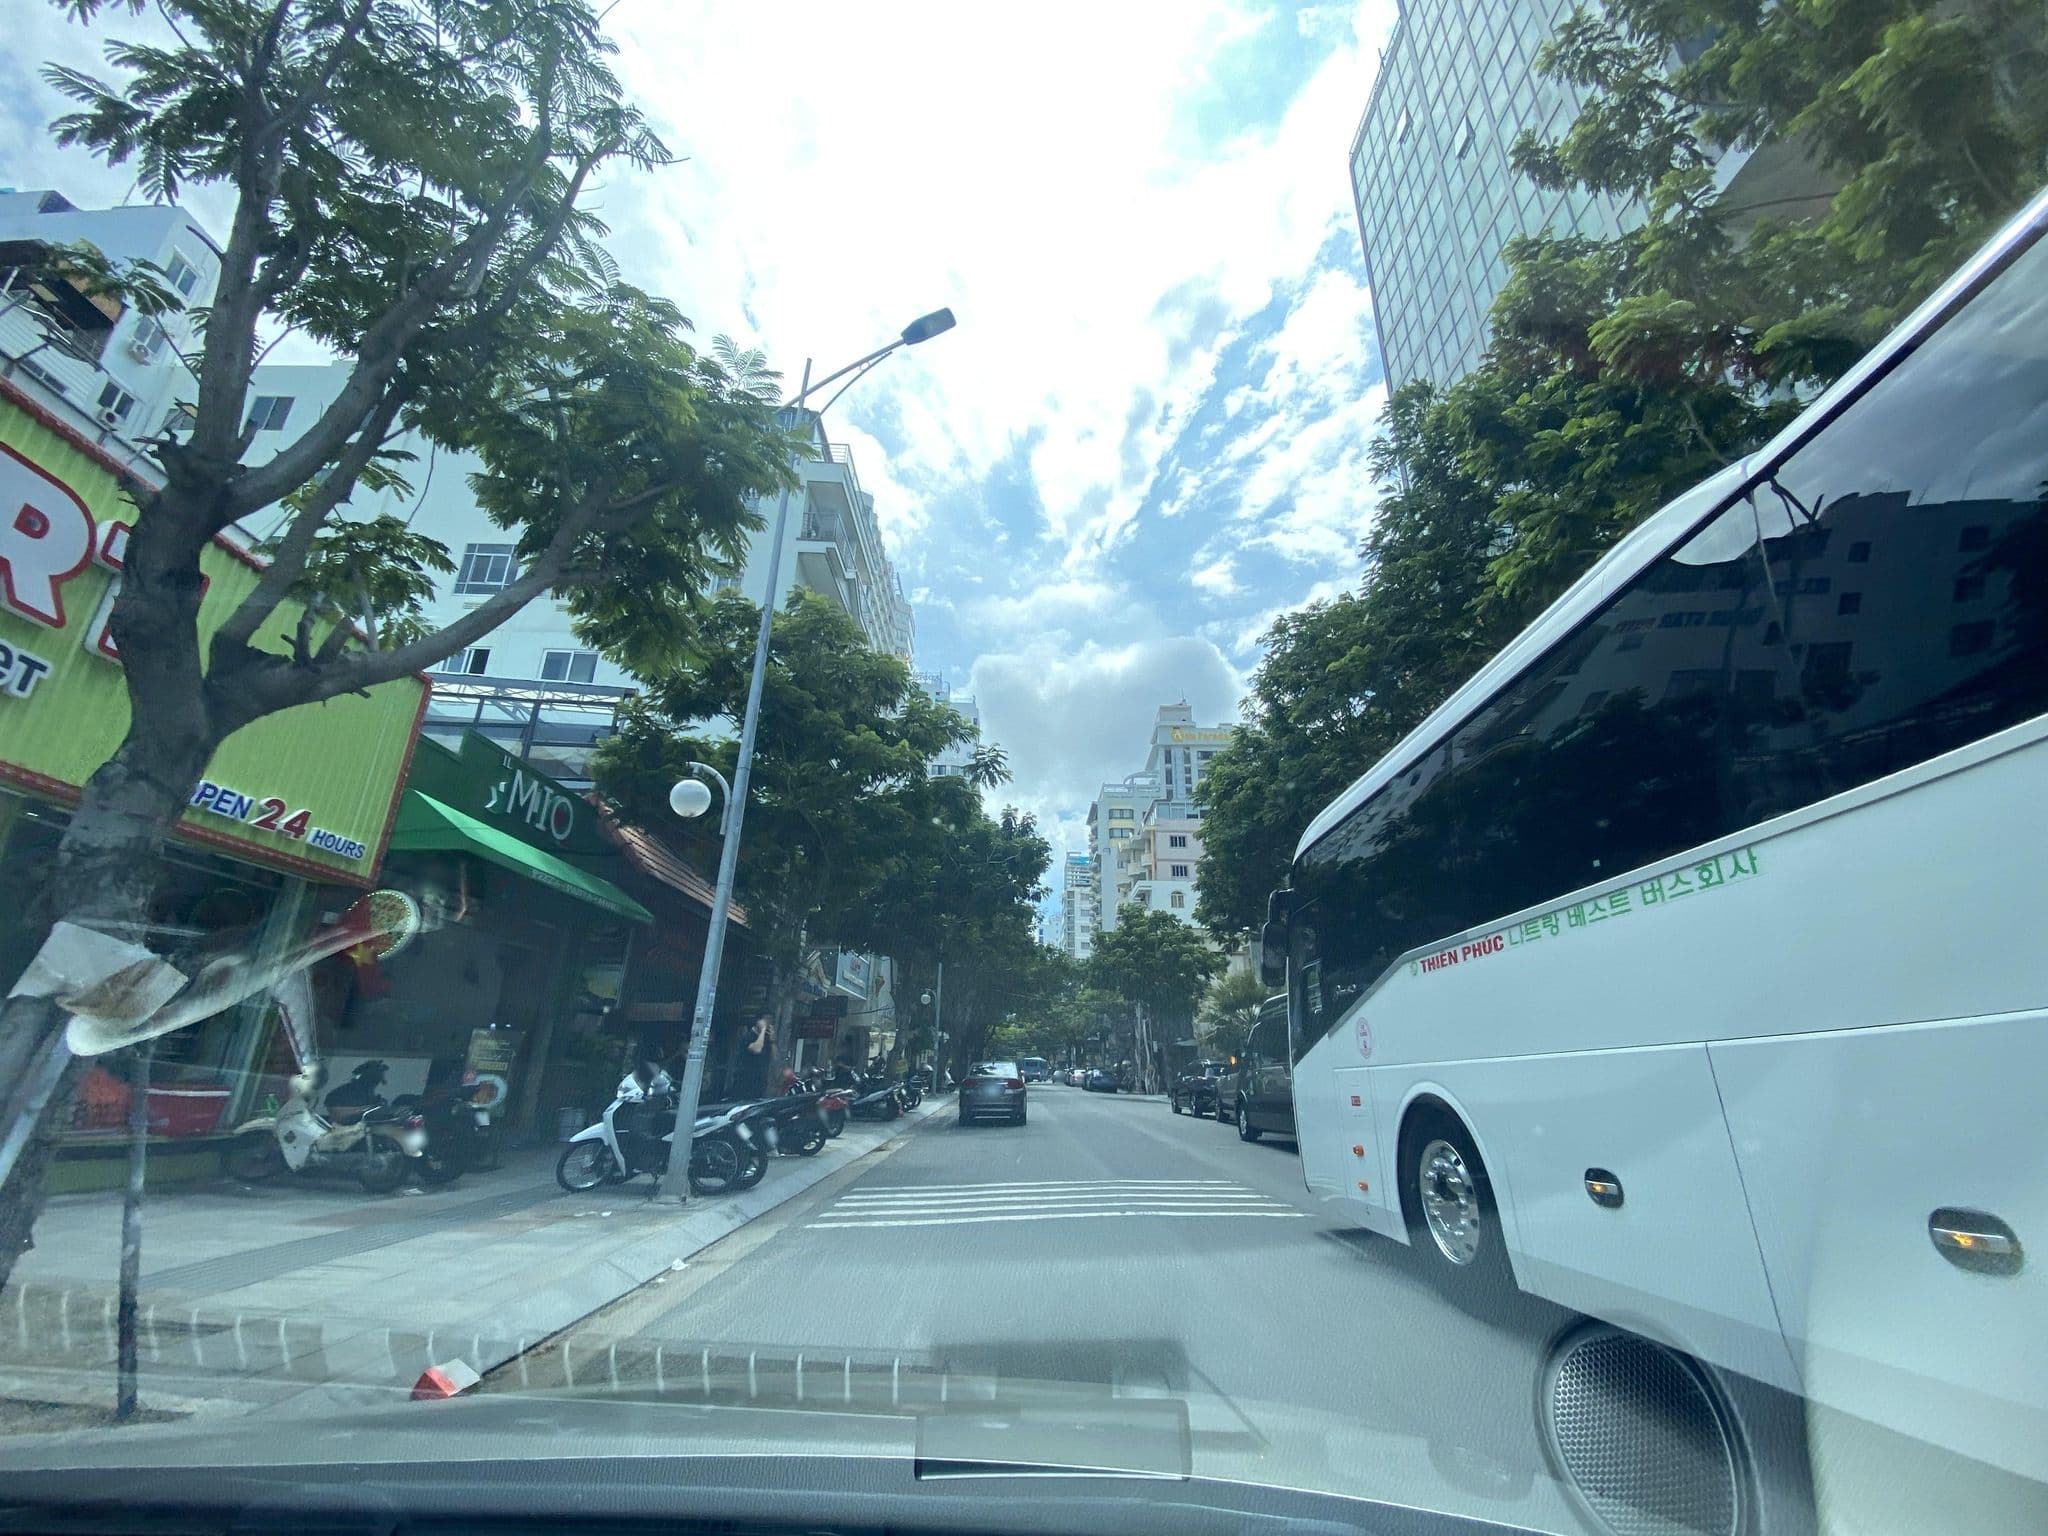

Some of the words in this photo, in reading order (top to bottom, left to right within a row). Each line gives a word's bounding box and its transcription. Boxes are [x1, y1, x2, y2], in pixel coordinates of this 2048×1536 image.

[188, 781, 255, 821] PEN
[251, 799, 312, 840] 24
[310, 828, 366, 859] HOURS
[506, 769, 574, 840] MIO
[1567, 889, 1632, 928] 베스트
[1640, 847, 1758, 905] 버스회사
[1462, 935, 1505, 961] PHÚC
